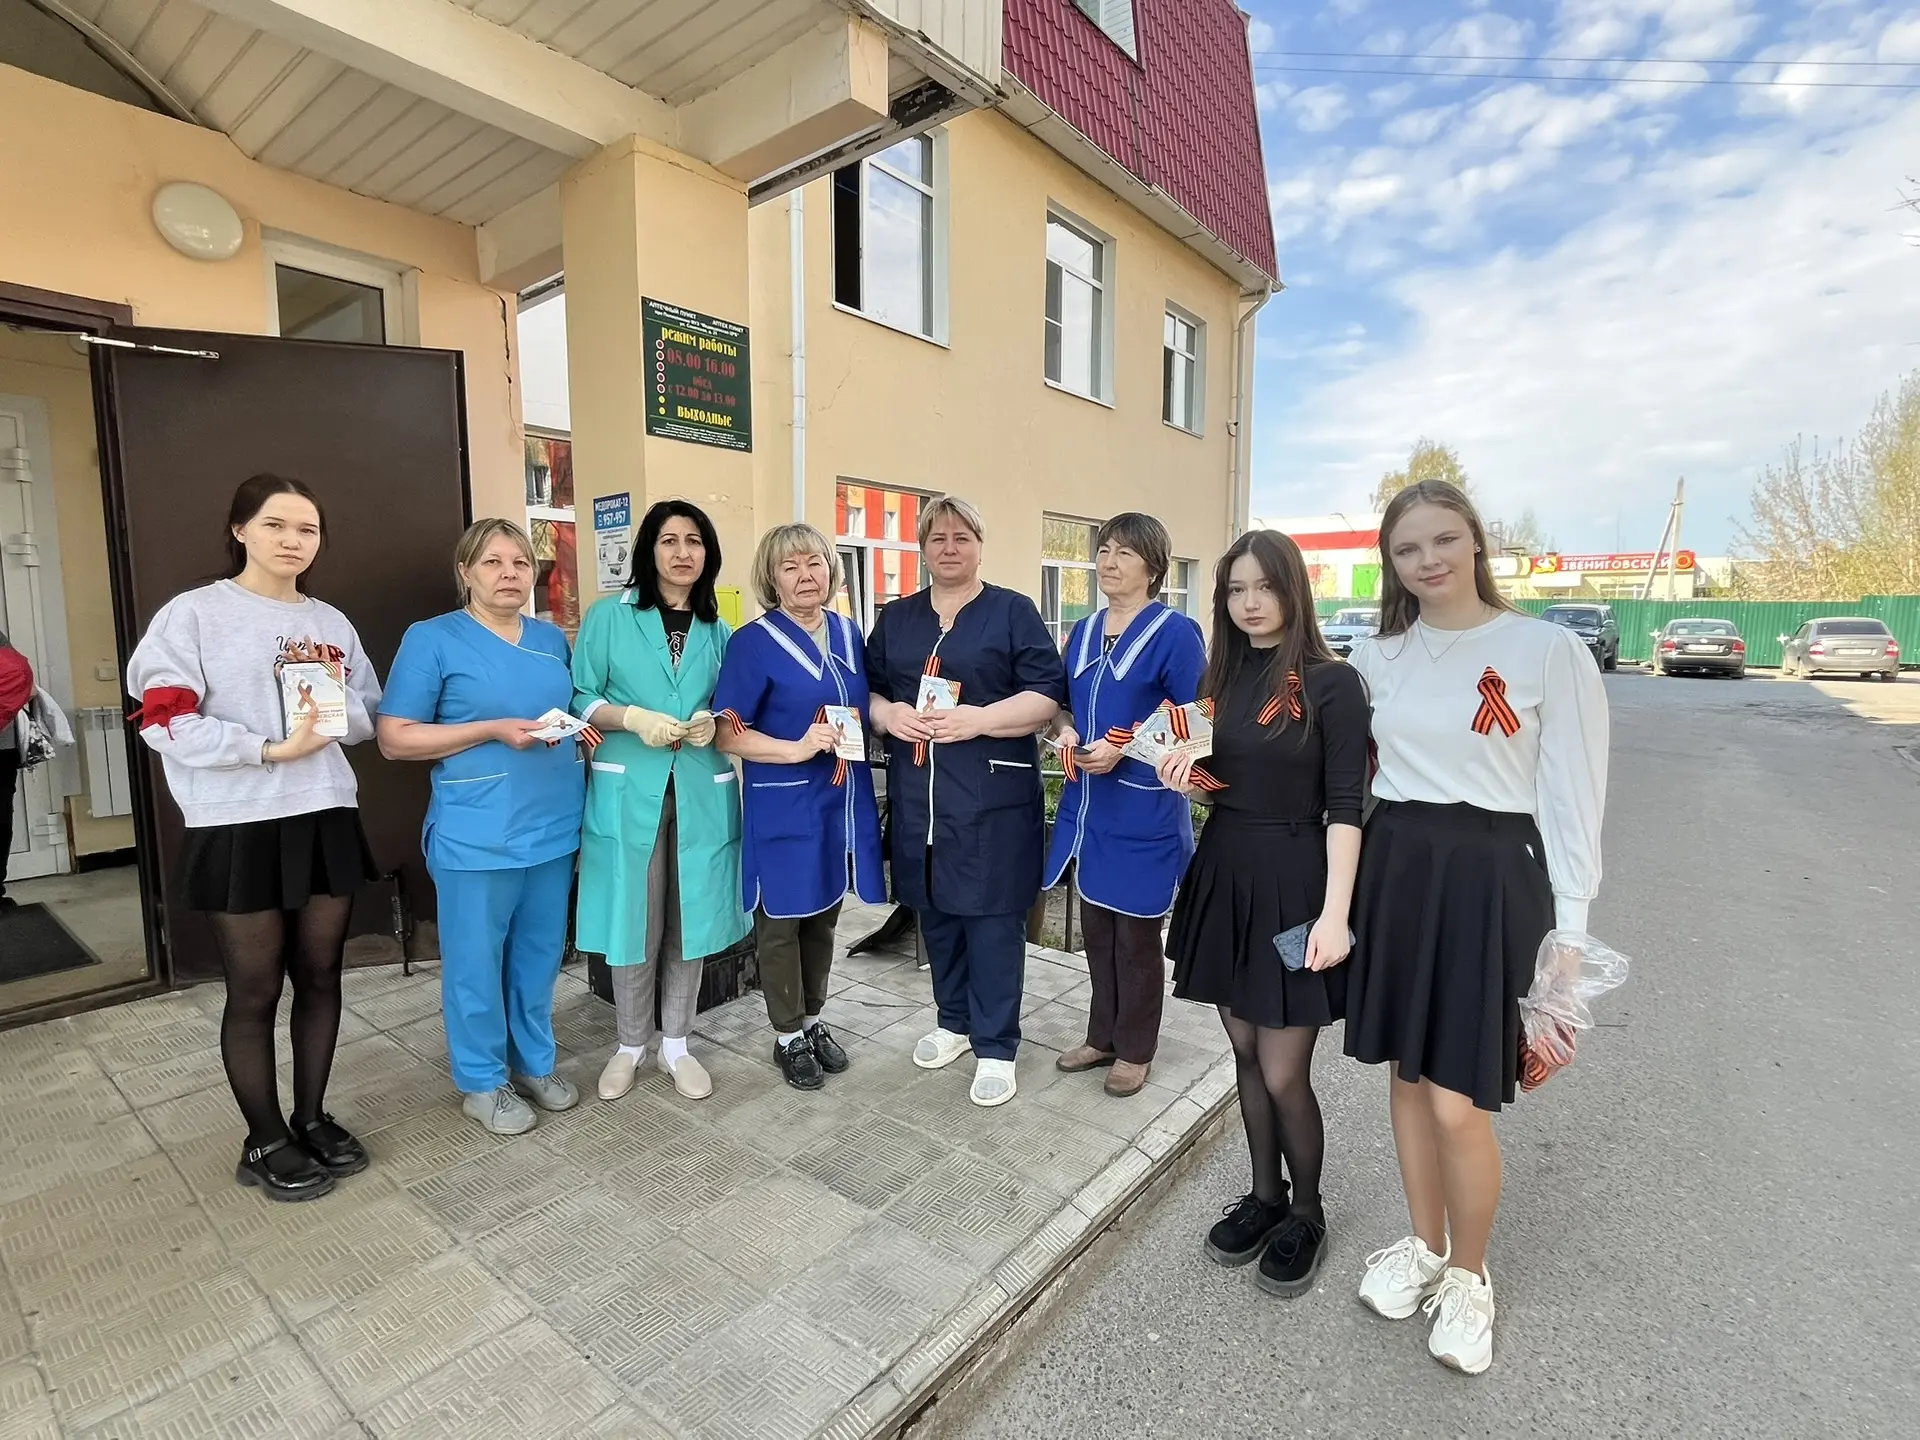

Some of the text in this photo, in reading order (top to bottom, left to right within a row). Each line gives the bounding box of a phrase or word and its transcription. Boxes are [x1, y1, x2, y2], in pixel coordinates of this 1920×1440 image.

[699, 336, 737, 357] работы
[666, 347, 736, 378] 08.00 16.00
